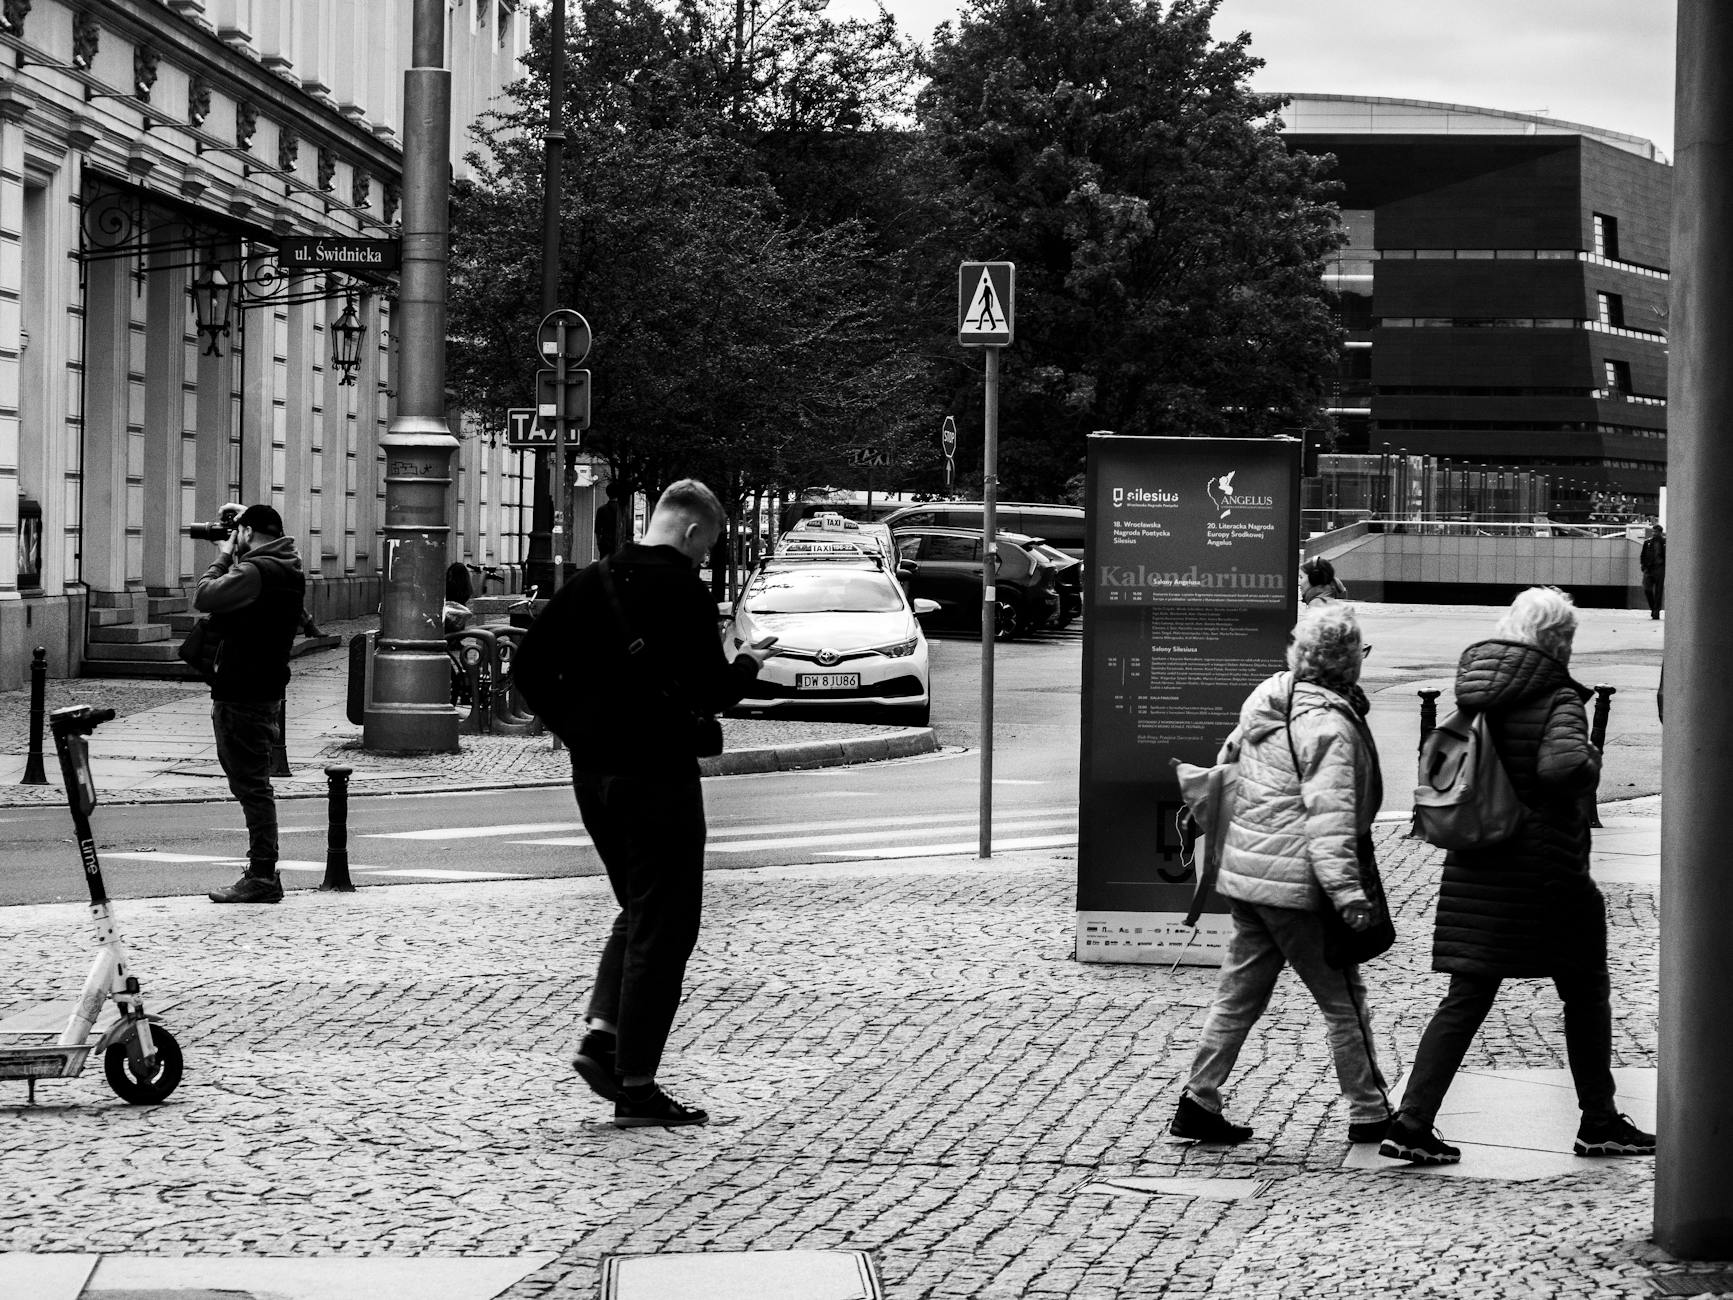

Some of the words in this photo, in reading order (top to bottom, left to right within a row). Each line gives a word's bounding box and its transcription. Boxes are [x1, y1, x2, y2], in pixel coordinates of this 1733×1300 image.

[295, 245, 312, 261] ul.
[316, 240, 382, 262] Świdnicka
[512, 414, 576, 440] TA
[1127, 488, 1179, 502] silesius
[1221, 496, 1273, 506] ANGELUS
[826, 518, 841, 527] TAXI
[1113, 529, 1140, 537] Nagroda
[1207, 531, 1230, 539] Europy
[1207, 539, 1233, 547] Angelus
[1101, 565, 1285, 589] Kalendarium
[804, 677, 818, 687] DW
[822, 676, 856, 686] 8JU86
[81, 838, 98, 875] Lime
